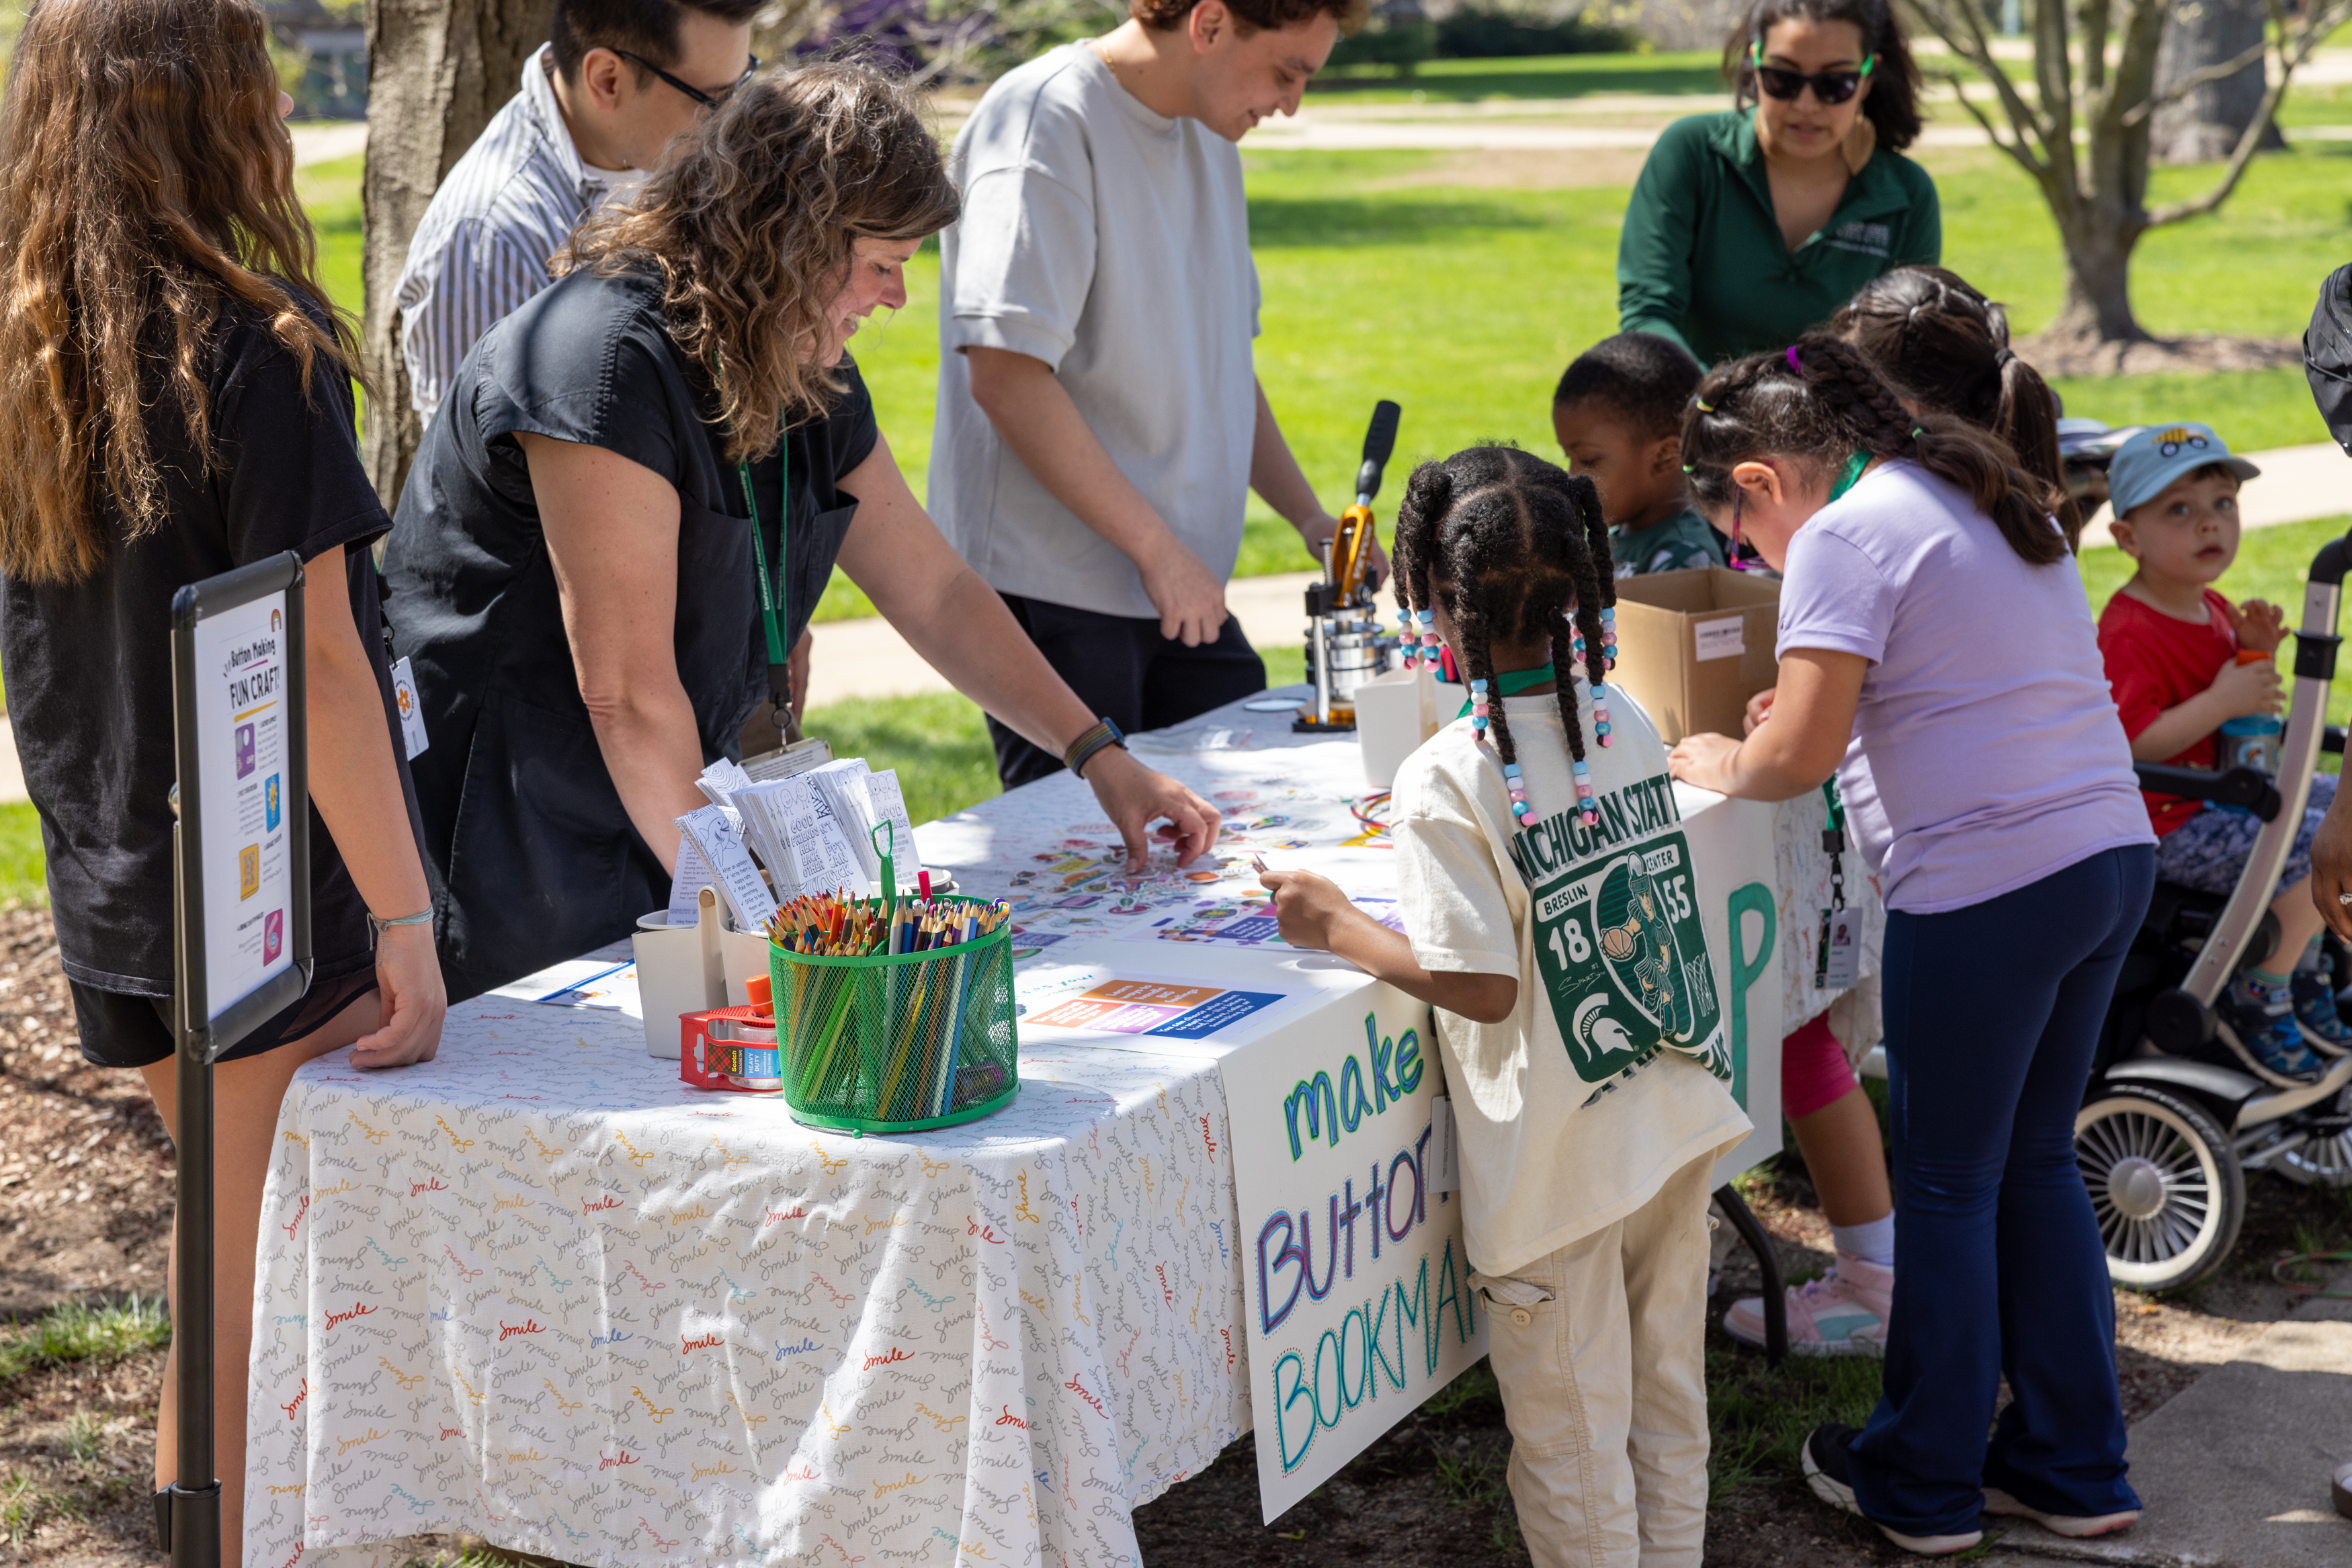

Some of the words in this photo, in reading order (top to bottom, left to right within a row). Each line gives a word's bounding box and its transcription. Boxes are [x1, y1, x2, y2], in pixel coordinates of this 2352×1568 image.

[231, 647, 252, 667] Button
[252, 638, 276, 659] Making
[230, 678, 249, 709] FUN
[251, 665, 280, 700] CRAFT!
[878, 803, 902, 820] GOOD
[790, 813, 814, 834] GOOD
[791, 826, 820, 847] FRIENDS
[799, 839, 816, 856] HELP
[801, 850, 821, 867] EACH
[802, 859, 825, 878] OTHER
[1646, 849, 1675, 871] CENTER
[734, 877, 745, 885] happy
[742, 887, 759, 898] something
[1544, 883, 1589, 914] BRESLIN
[1663, 874, 1692, 924] 55
[752, 908, 769, 918] something
[1548, 918, 1591, 971] 18
[1105, 985, 1134, 996] Learn
[1134, 987, 1166, 1000] handle
[1164, 989, 1199, 1003] feelings
[1184, 1010, 1207, 1021] choose
[1205, 1002, 1223, 1010] what
[1222, 994, 1240, 1003] want
[1185, 1018, 1204, 1027] work
[1223, 998, 1247, 1006] being
[1209, 1012, 1245, 1027] something
[1283, 1010, 1424, 1163] make
